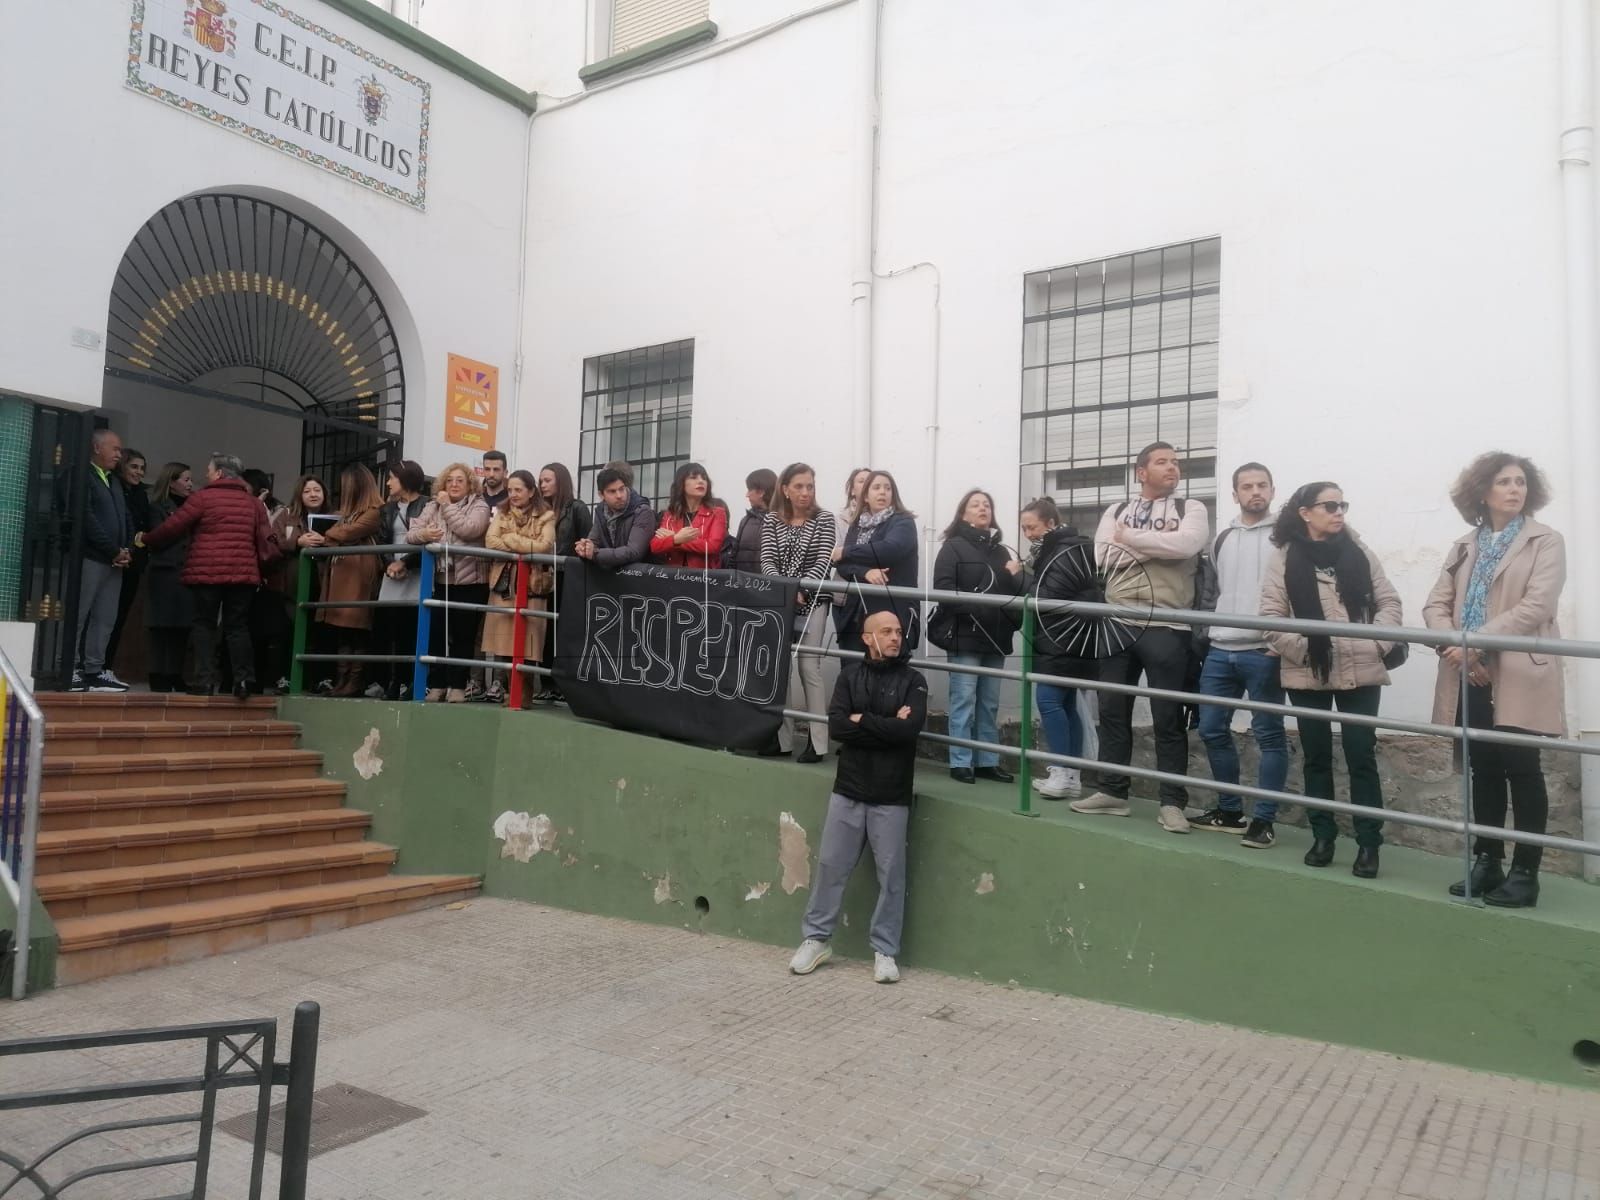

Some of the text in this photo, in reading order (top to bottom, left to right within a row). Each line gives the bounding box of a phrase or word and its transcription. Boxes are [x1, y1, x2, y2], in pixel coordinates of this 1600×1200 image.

[254, 22, 337, 88] C.E.I.P.
[145, 32, 412, 177] REYES CATÓLICOS
[724, 575, 740, 589] de
[744, 577, 772, 592] 2022
[576, 592, 785, 705] RESPETO
